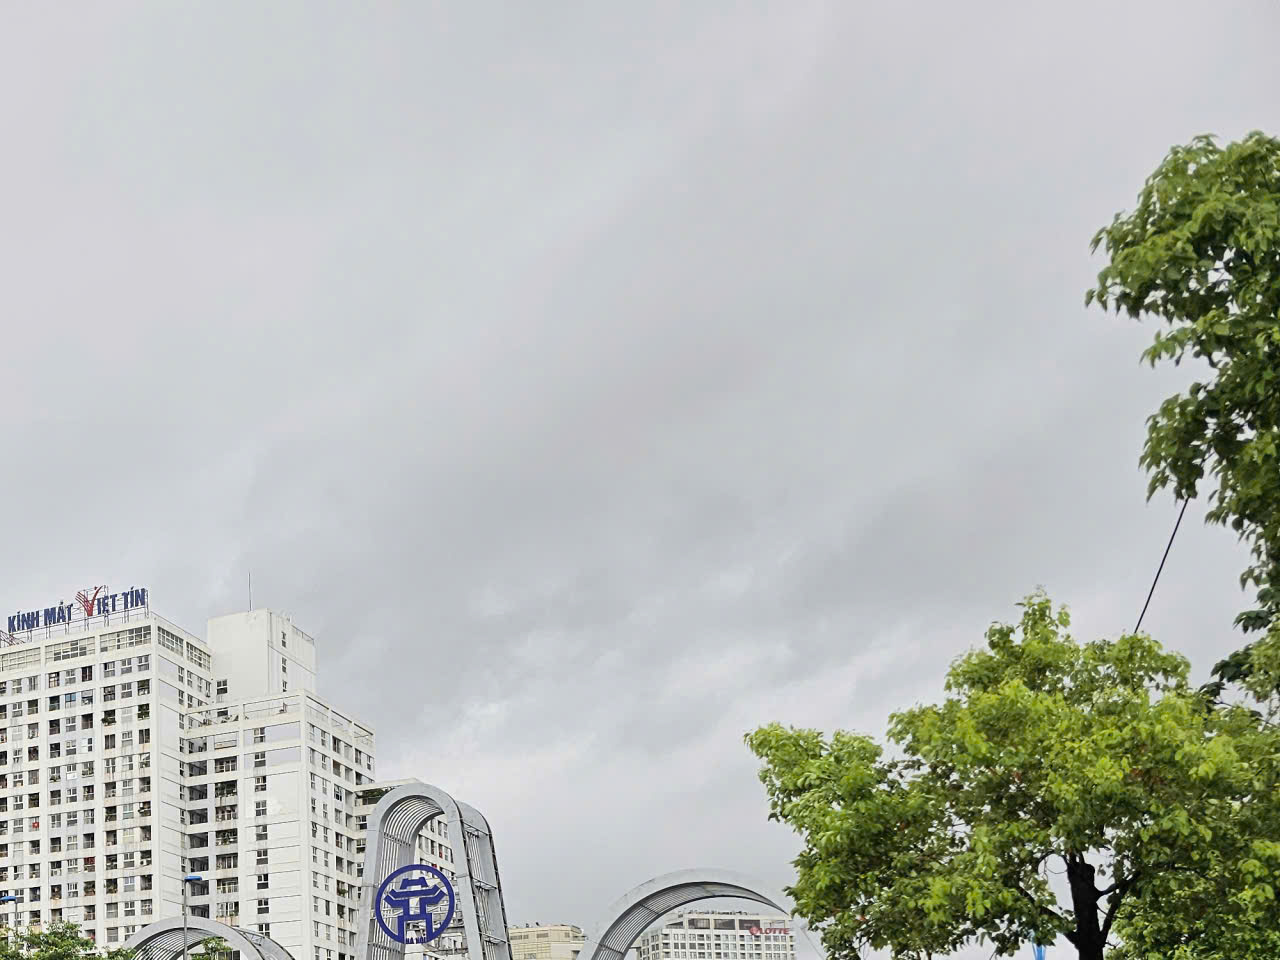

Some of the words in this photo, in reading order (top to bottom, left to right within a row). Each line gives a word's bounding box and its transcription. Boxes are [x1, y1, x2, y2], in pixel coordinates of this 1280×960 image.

[7, 610, 40, 633] KÍNH
[122, 586, 146, 609] TÍN
[760, 927, 790, 935] LOTTE
